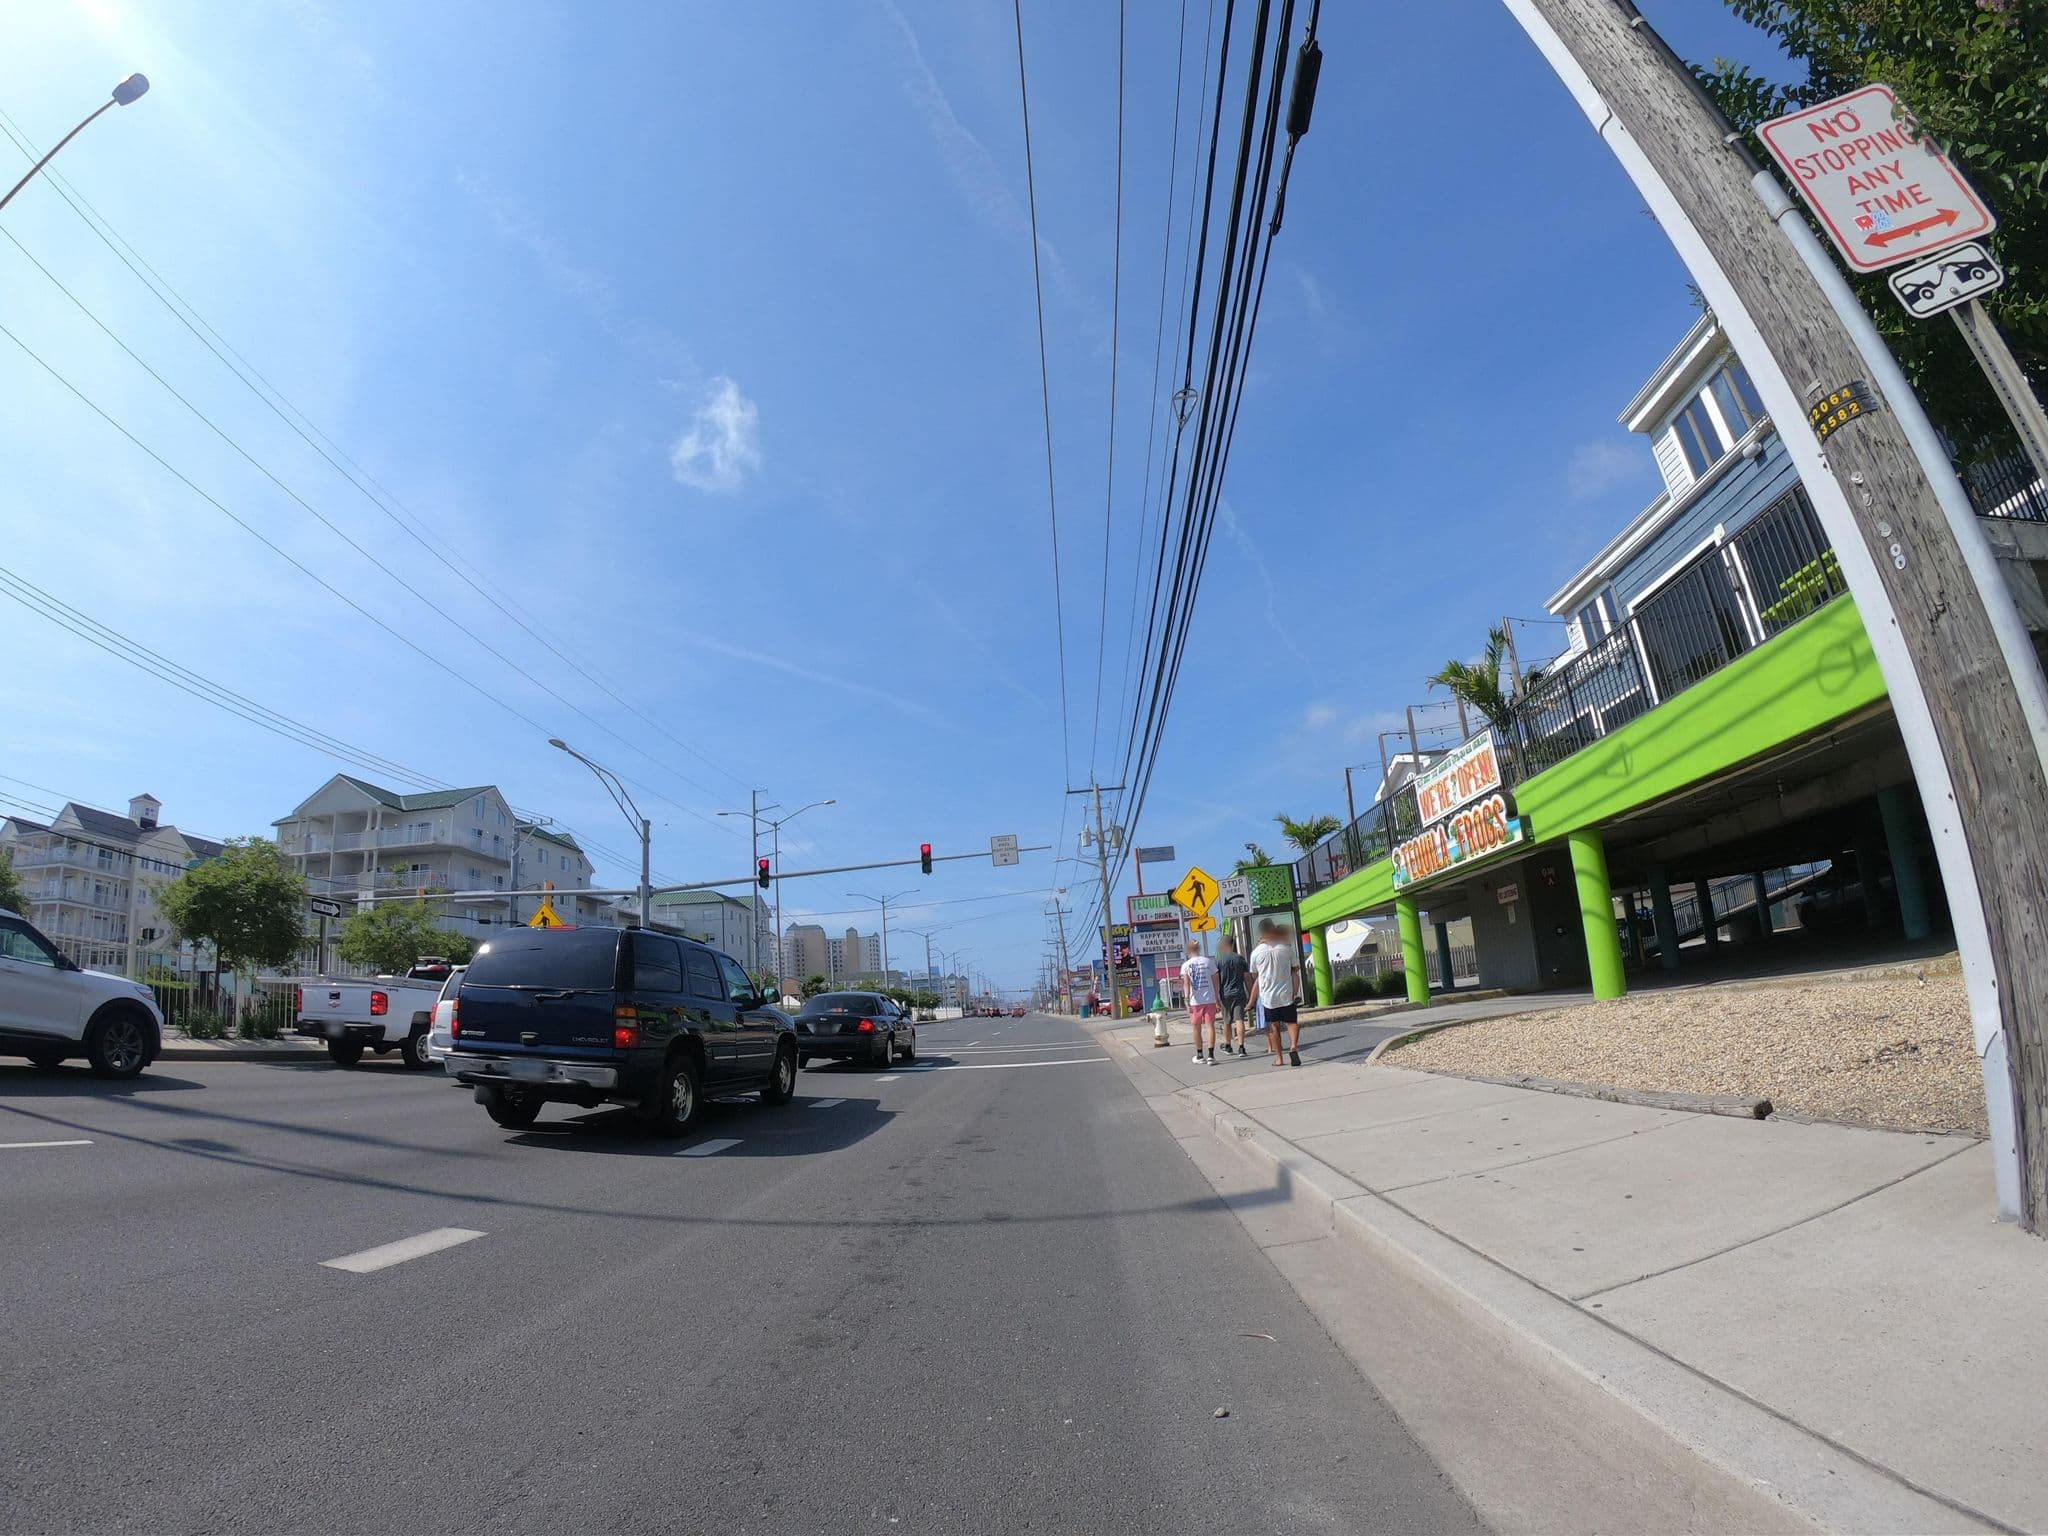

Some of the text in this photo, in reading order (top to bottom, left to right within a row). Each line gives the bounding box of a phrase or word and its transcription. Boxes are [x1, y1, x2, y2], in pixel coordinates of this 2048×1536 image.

[1806, 111, 1861, 144] NO
[1847, 159, 1904, 196] ANY
[1856, 183, 1932, 216] TIME
[1419, 773, 1454, 822] WE'RE
[1401, 799, 1508, 880] TEQUILA FROGS
[1221, 878, 1243, 889] STOP
[1137, 913, 1148, 922] EAT
[1232, 905, 1250, 915] RED
[1140, 932, 1160, 940] HAPPY
[1145, 938, 1163, 946] DAILY
